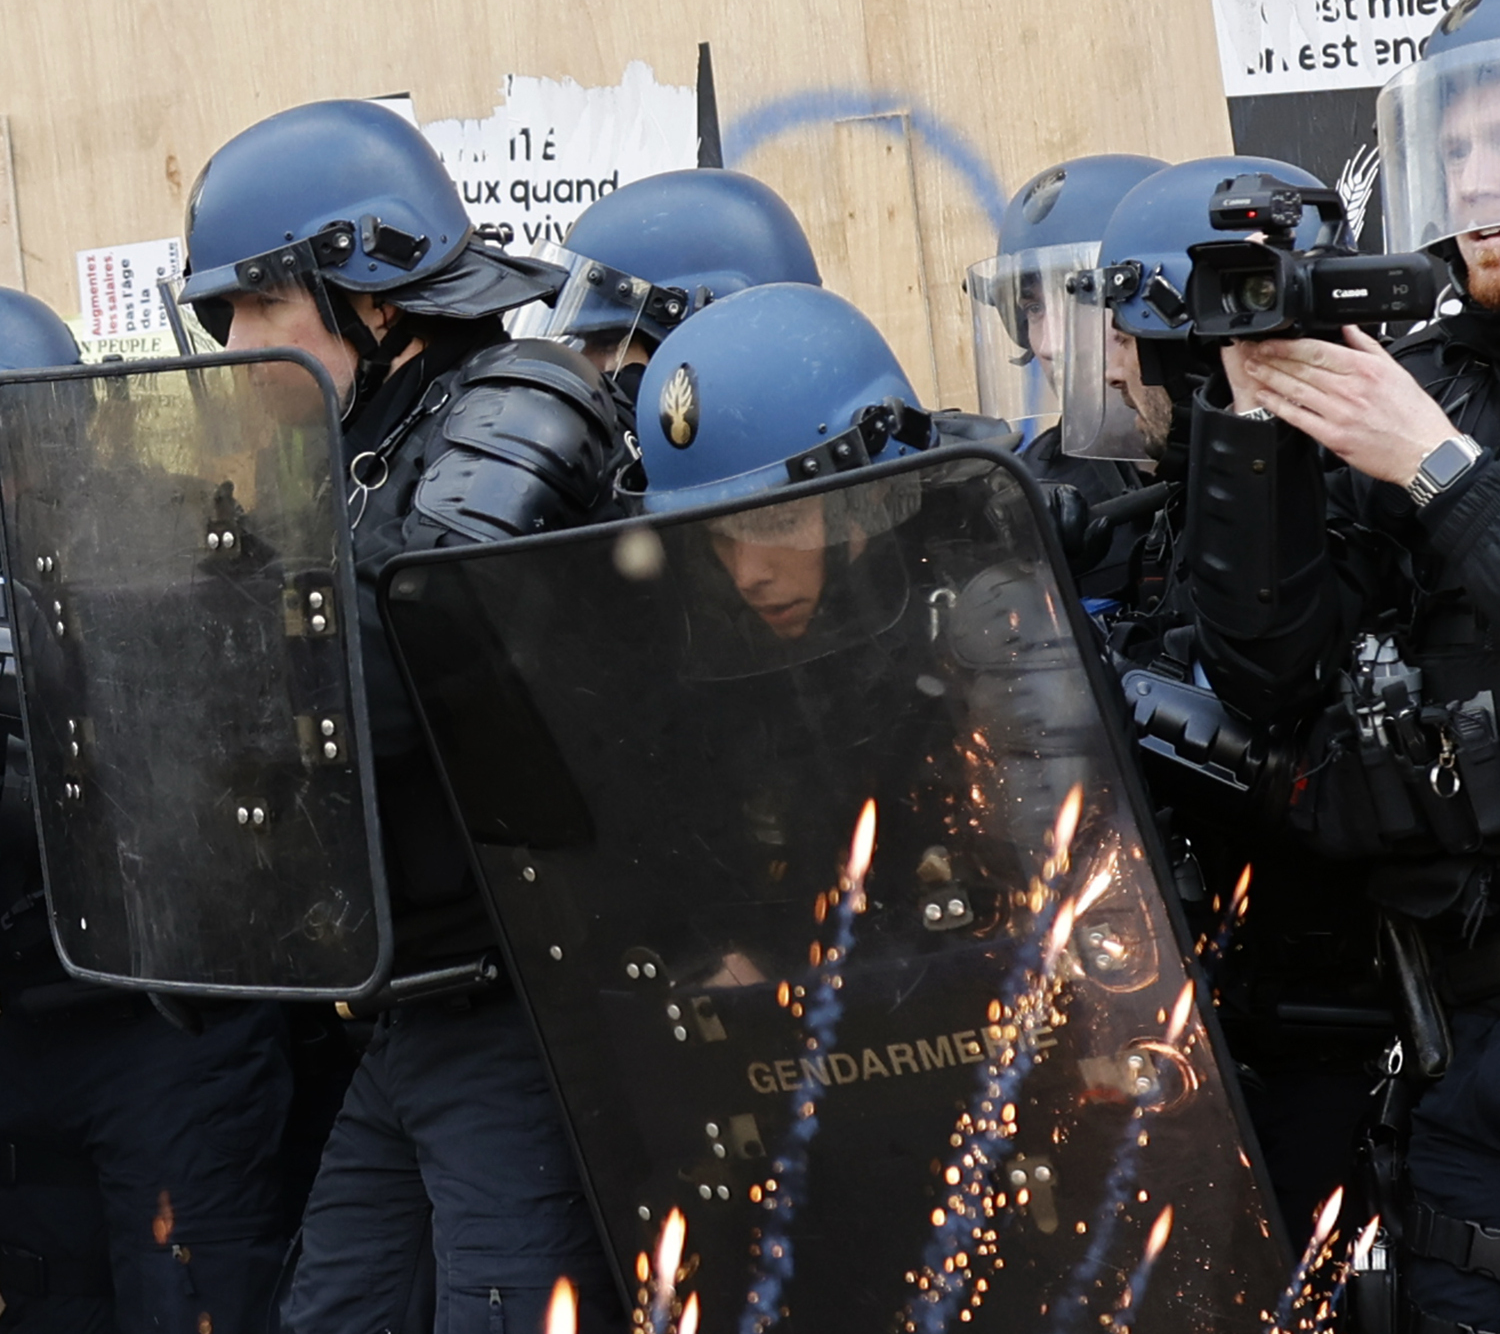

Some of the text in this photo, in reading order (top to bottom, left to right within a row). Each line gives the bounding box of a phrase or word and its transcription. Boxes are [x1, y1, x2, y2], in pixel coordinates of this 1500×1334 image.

[509, 169, 619, 212] quand
[86, 254, 103, 337] Augmentez
[140, 288, 151, 329] de la
[1331, 288, 1369, 299] Canon
[126, 302, 136, 332] pas
[97, 337, 162, 354] PEUPLE
